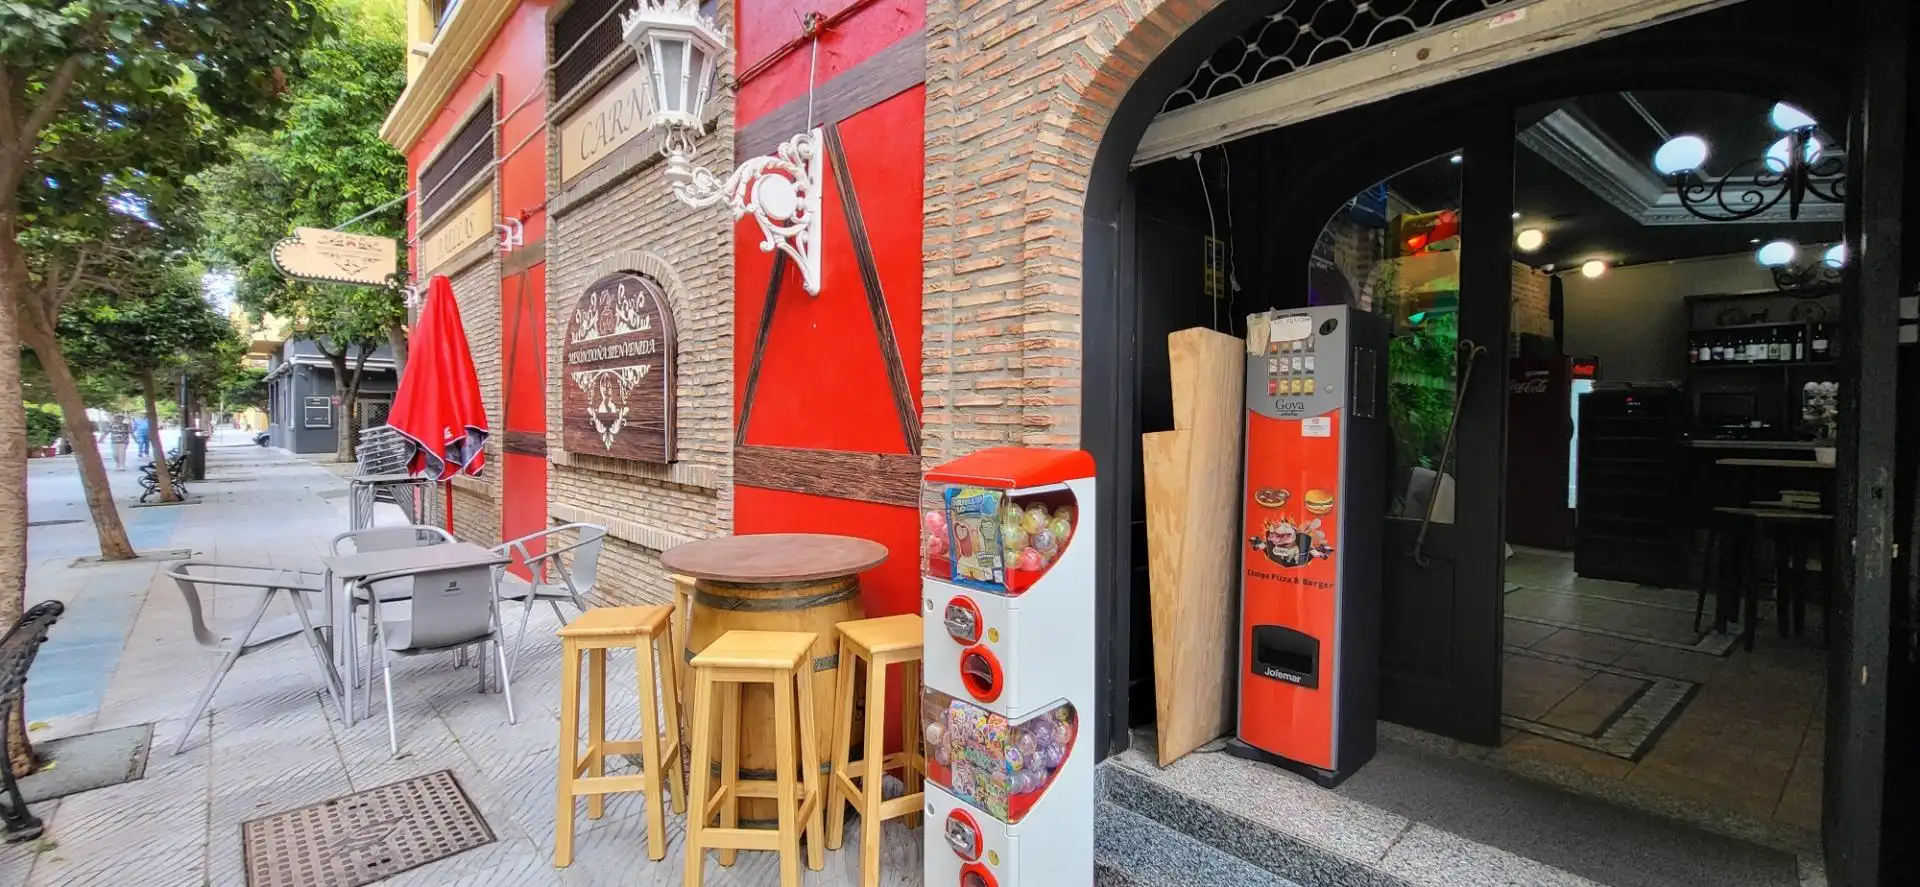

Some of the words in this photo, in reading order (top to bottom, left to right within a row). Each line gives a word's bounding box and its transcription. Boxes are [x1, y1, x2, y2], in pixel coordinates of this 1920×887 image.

[580, 87, 651, 160] CARN
[1275, 399, 1305, 411] Goya
[1271, 573, 1292, 583] Pizza
[1302, 578, 1334, 589] Burger
[1264, 667, 1301, 683] Jofemar
